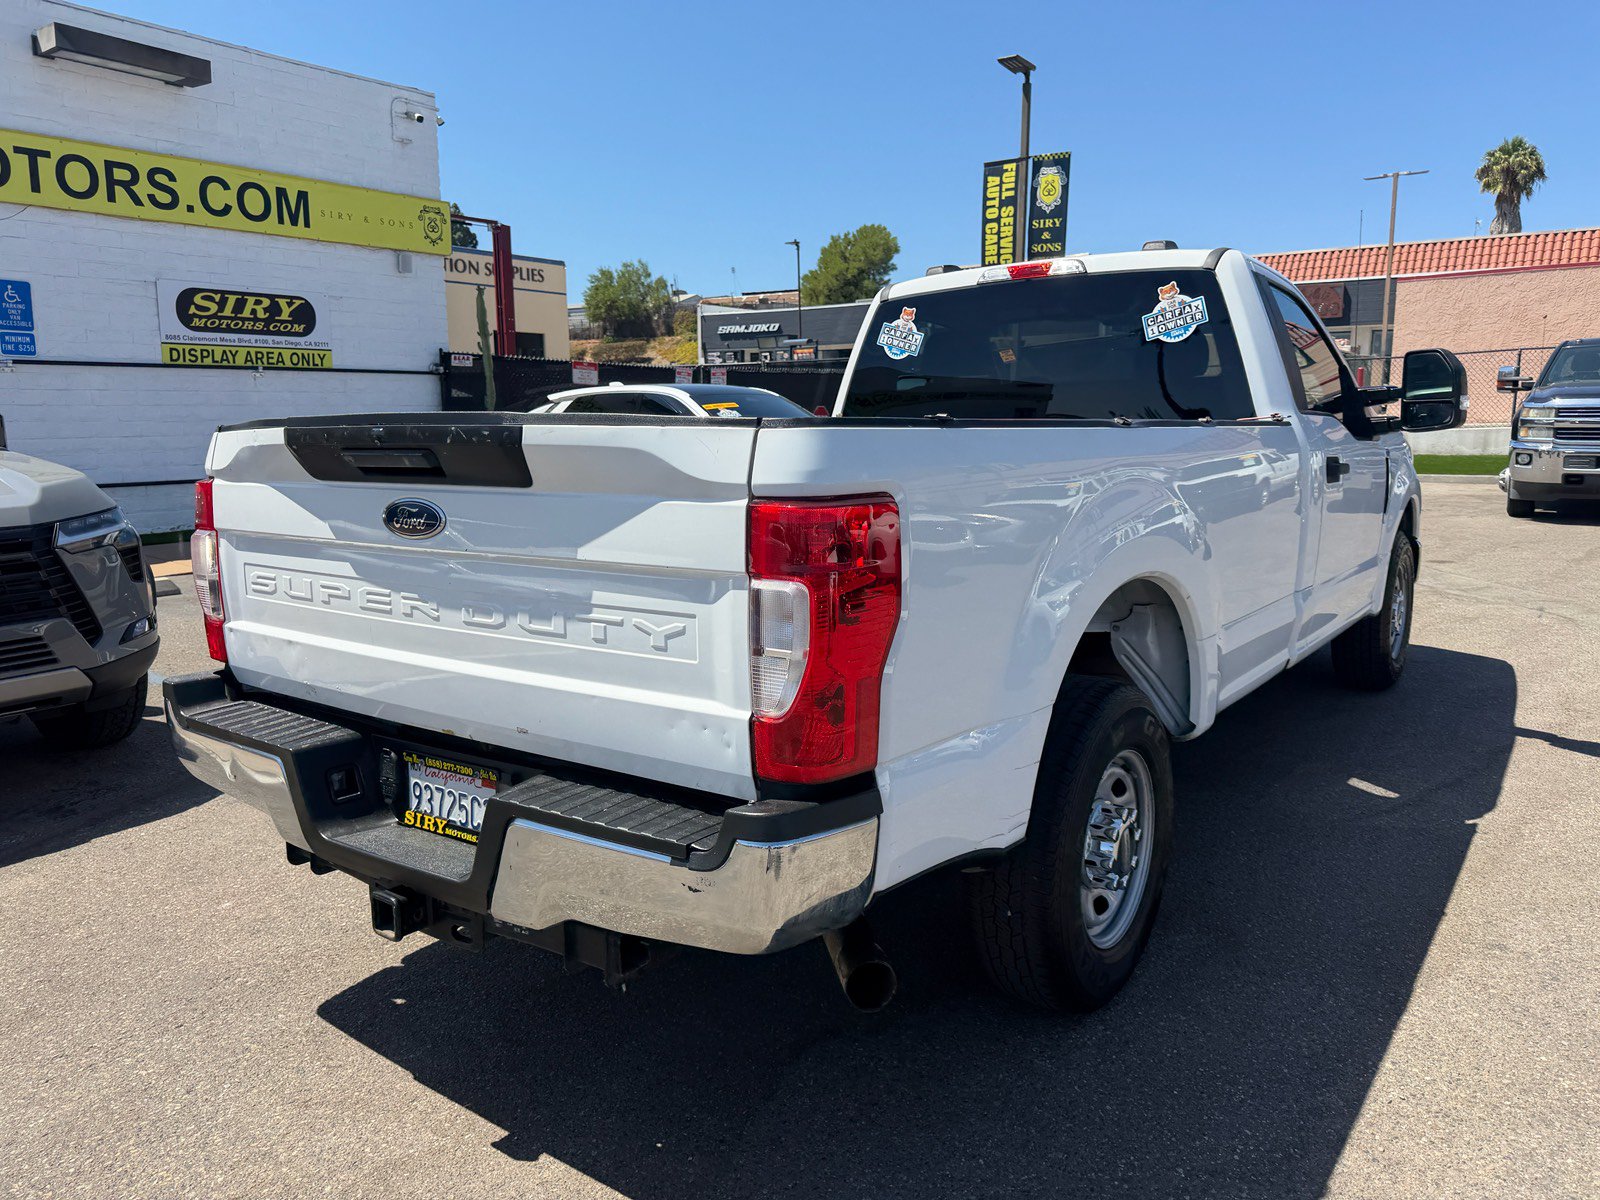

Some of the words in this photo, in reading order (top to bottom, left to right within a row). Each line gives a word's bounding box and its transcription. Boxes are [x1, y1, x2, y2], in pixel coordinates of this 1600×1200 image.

[0, 145, 311, 228] TORS.COM
[1002, 163, 1016, 199] FULL
[986, 176, 1000, 219] AUTO
[320, 210, 352, 221] SIRY
[379, 218, 414, 229] SONS
[1032, 218, 1062, 229] SIRY
[985, 222, 998, 265] CARE
[1041, 232, 1051, 240] &
[1031, 243, 1062, 253] SONS
[484, 261, 545, 283] SPLIES
[188, 292, 305, 320] SIRY
[1147, 304, 1201, 326] CARFAX
[190, 317, 306, 333] MOTORS.COM
[717, 323, 780, 334] SAMJOKO
[1149, 328, 1156, 336] 1
[1158, 313, 1203, 333] OWNER
[5, 335, 31, 343] MINIMUM
[165, 333, 181, 341] 8085
[182, 334, 218, 343] Clairemont
[884, 327, 920, 344] CARFAX
[887, 337, 917, 352] OWNER
[18, 344, 35, 352] $250
[169, 347, 239, 364] DISPLAY
[244, 350, 286, 366] AREA
[290, 352, 327, 367] ONLY
[393, 506, 426, 530] Ford
[250, 571, 440, 622] SUPER
[461, 606, 686, 652] DUTY
[425, 757, 442, 770] (858)
[443, 762, 473, 776] 277-7300
[425, 767, 481, 787] California
[404, 810, 447, 834] SIRY
